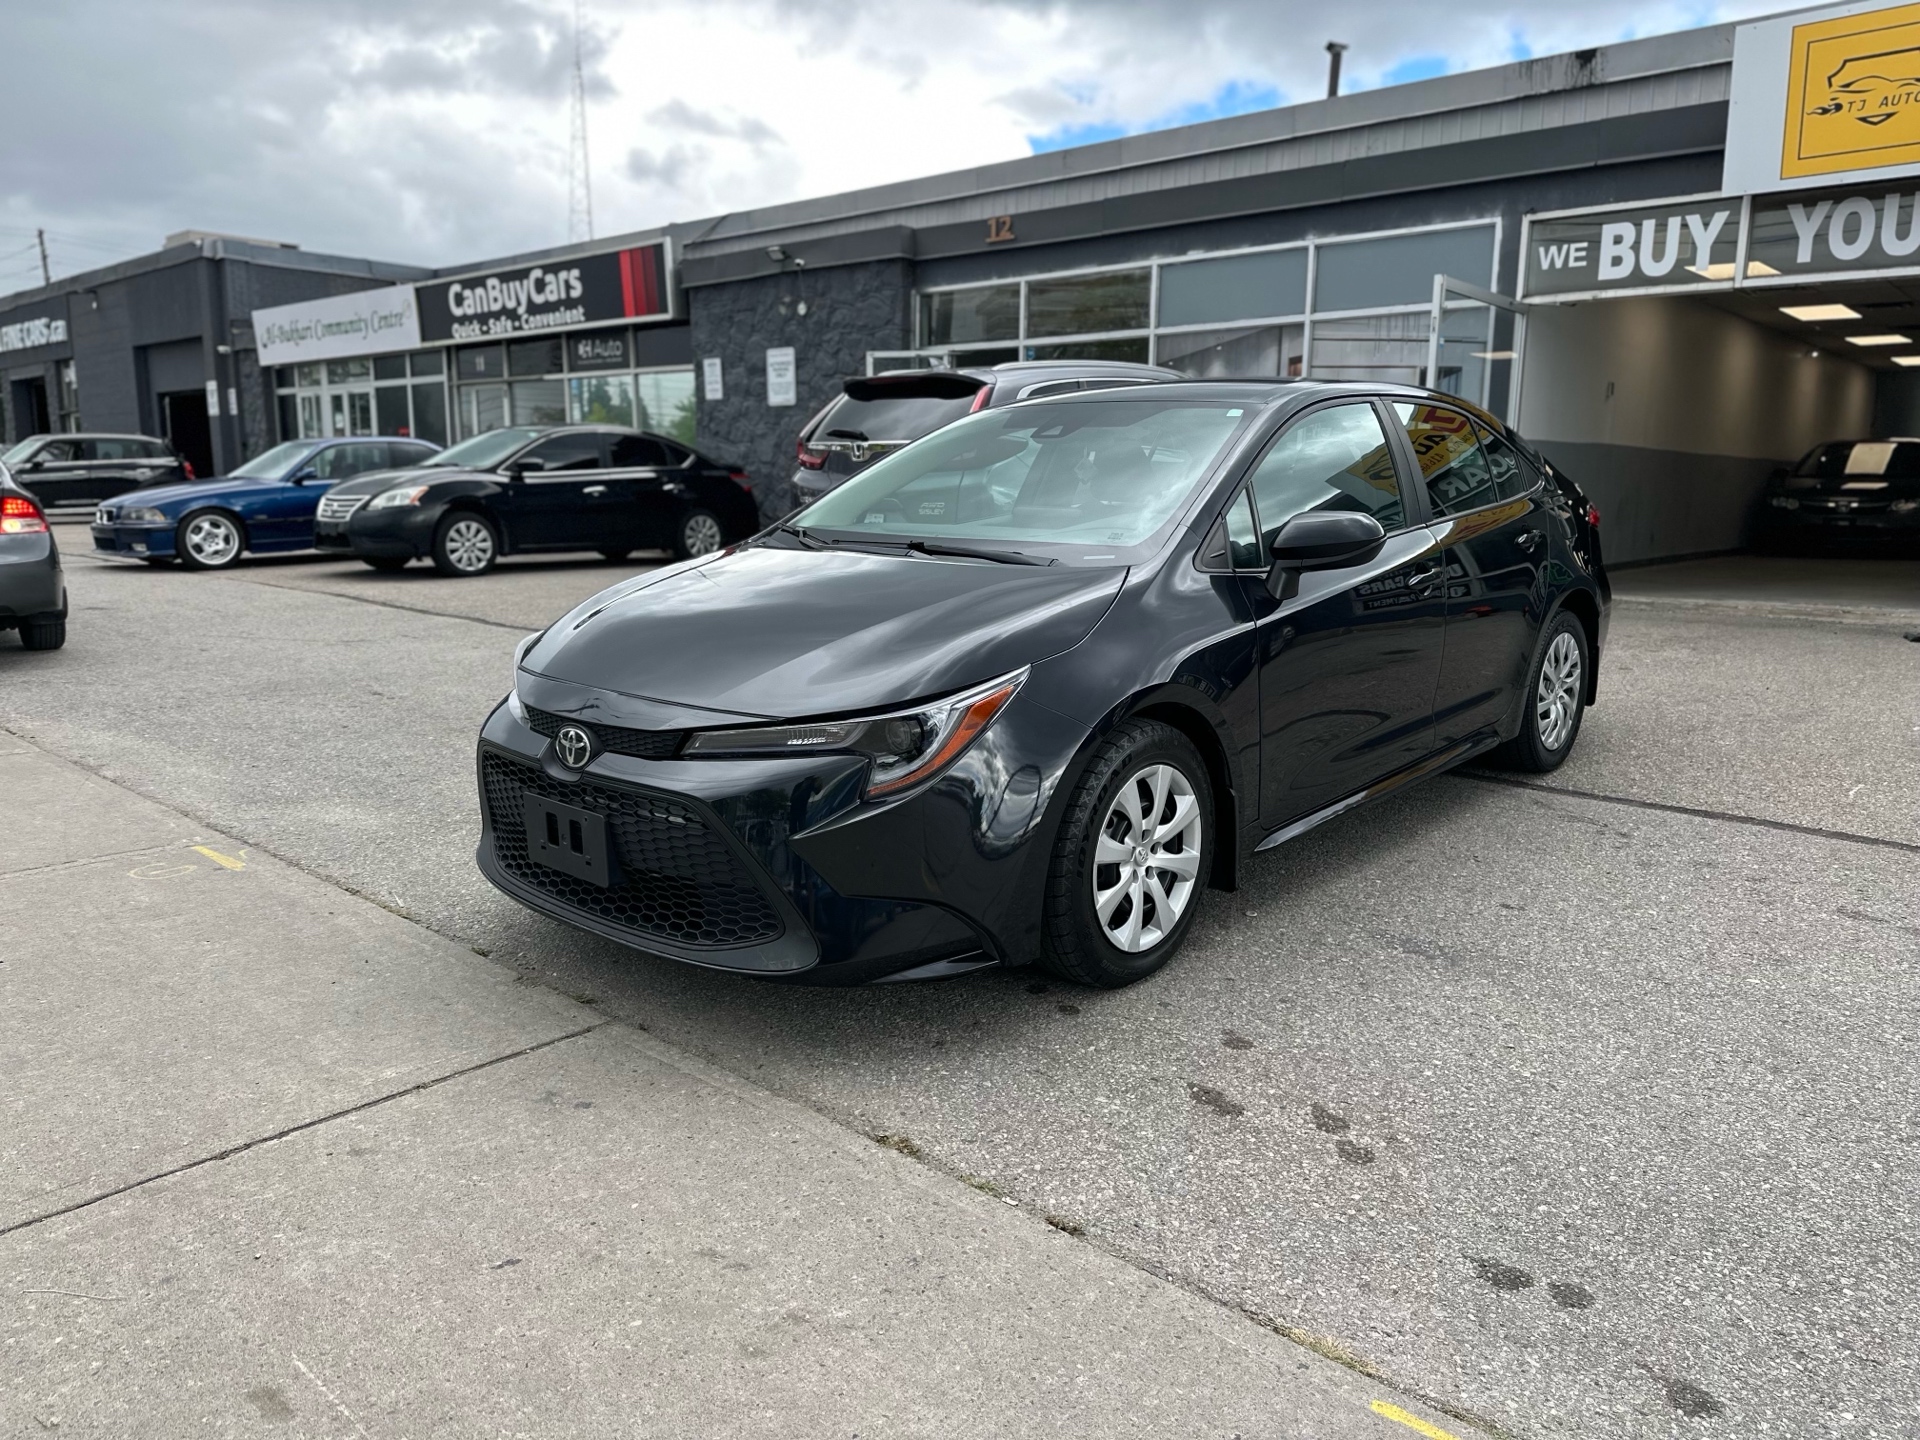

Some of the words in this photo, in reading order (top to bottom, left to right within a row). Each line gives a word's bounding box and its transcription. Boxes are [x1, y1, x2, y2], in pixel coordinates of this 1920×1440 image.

[1847, 99, 1867, 113] TJ
[985, 215, 1015, 243] 12
[1538, 242, 1588, 270] WE
[1598, 210, 1730, 281] BUY
[1787, 193, 1920, 264] YOU
[448, 268, 583, 316] CanBuyCars
[314, 312, 368, 340] Community
[370, 310, 404, 333] Centre
[451, 320, 481, 339] Quick
[488, 315, 513, 334] Safe
[521, 305, 586, 330] Convenient
[593, 339, 623, 357] Auto
